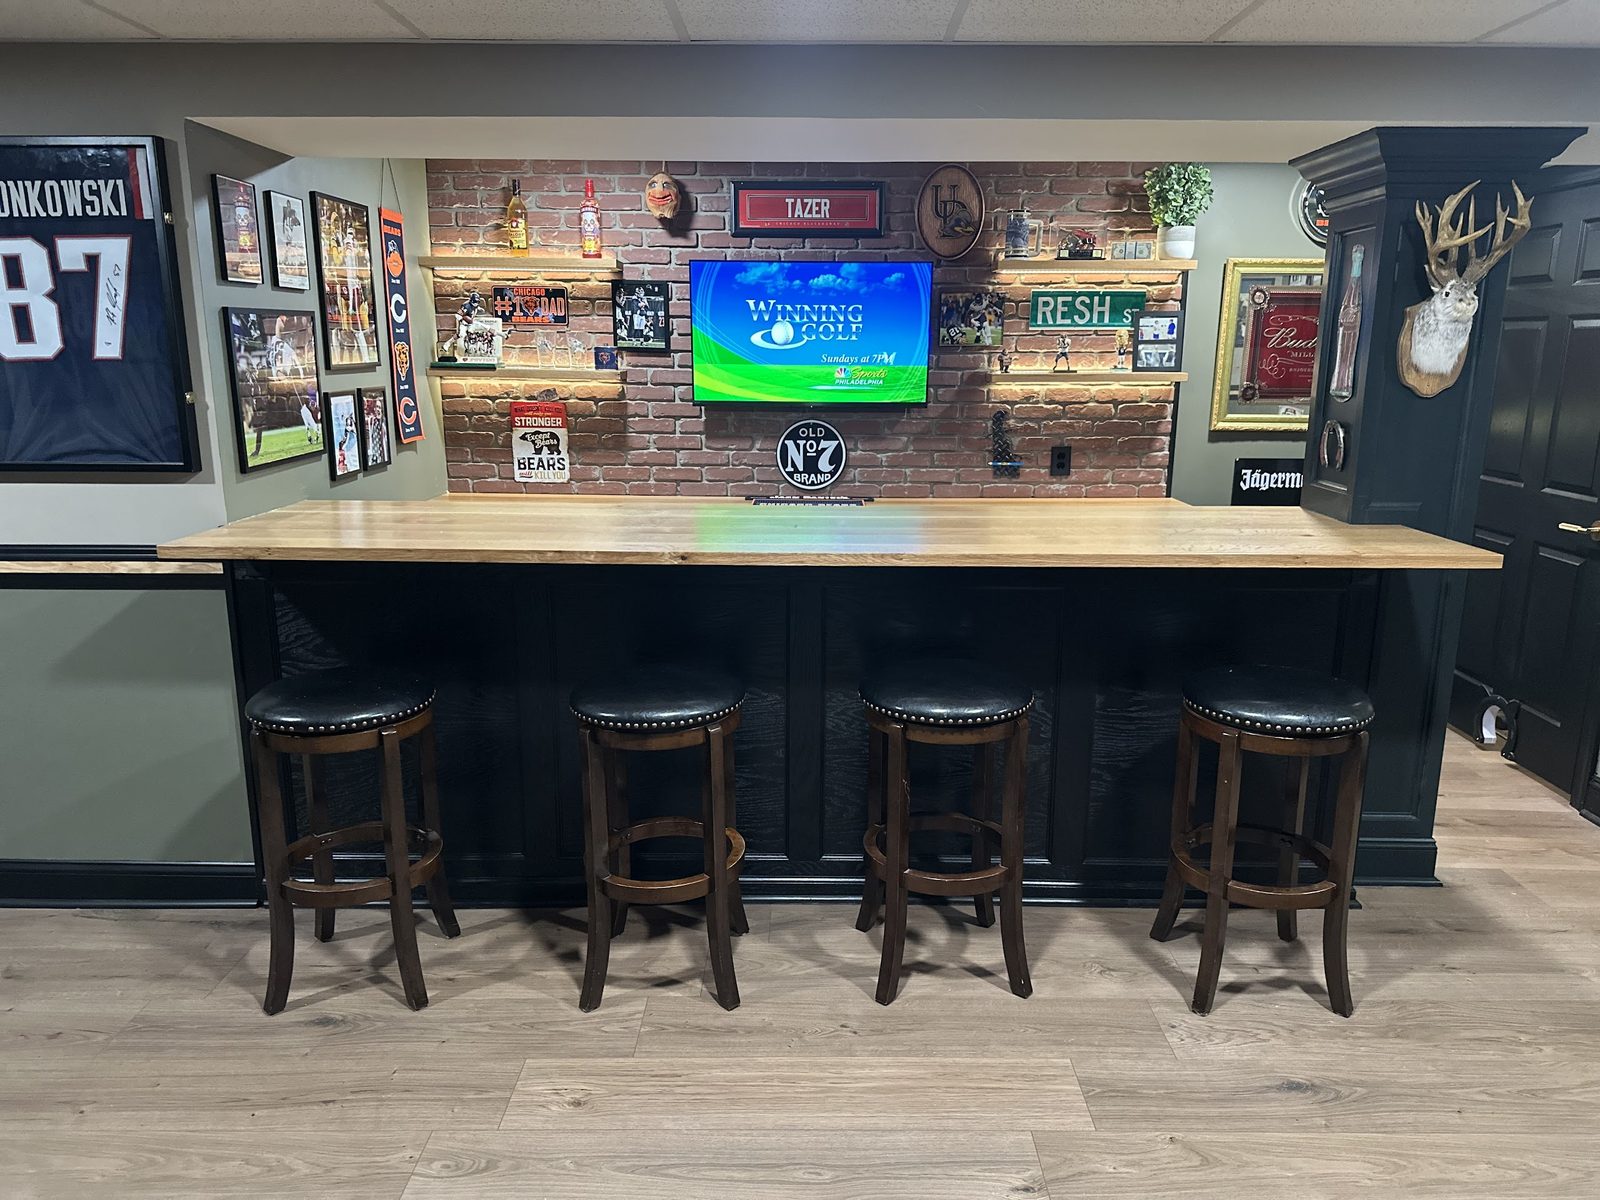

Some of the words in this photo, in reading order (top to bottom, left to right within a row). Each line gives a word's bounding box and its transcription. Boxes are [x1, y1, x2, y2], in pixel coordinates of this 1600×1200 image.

[785, 198, 830, 218] TAZER
[0, 234, 132, 361] 87
[513, 288, 546, 296] CHICAGO
[494, 295, 524, 316] #1
[540, 297, 565, 316] DAD
[746, 299, 863, 322] WINNING
[1036, 295, 1111, 325] RESH
[511, 315, 550, 323] BEARS
[801, 323, 863, 341] GOLF
[820, 353, 859, 365] Sundays
[860, 355, 870, 363] at
[871, 351, 897, 366] 7PM
[851, 366, 887, 380] Sports
[514, 417, 562, 427] STRONGER
[526, 432, 551, 442] Except
[798, 427, 825, 437] OLD
[535, 438, 558, 449] Bears
[517, 457, 566, 470] BEARS
[535, 471, 552, 480] KILL
[552, 471, 566, 480] YOU
[793, 473, 832, 485] BRAND
[1240, 469, 1304, 491] Jägerm
